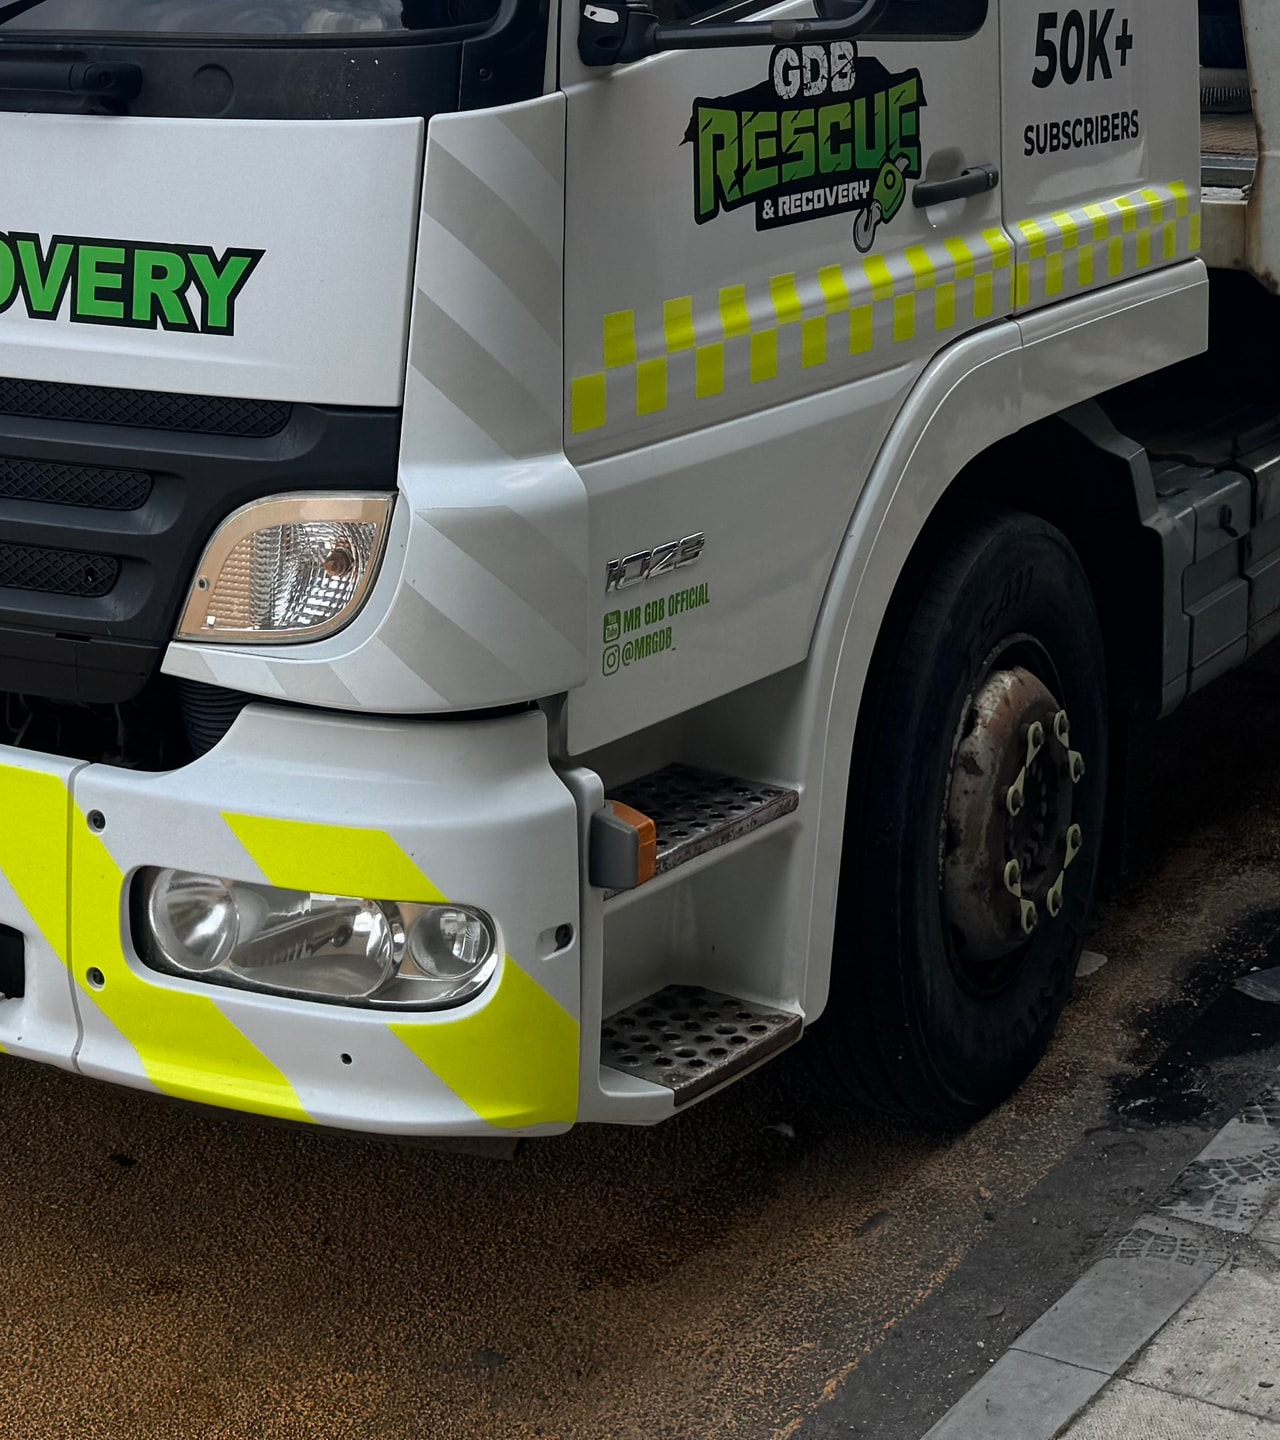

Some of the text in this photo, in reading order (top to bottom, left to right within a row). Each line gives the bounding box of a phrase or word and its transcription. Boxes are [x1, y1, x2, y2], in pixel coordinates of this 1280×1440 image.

[773, 40, 856, 101] GDB
[1031, 8, 1134, 89] 50K+
[696, 77, 920, 217] RESCUE
[1023, 109, 1140, 158] SUBSCRIBERS
[762, 179, 871, 220] & RECOVERY
[623, 582, 710, 634] MR GDB OFFICIAL
[622, 626, 677, 667] @MRGDB_
